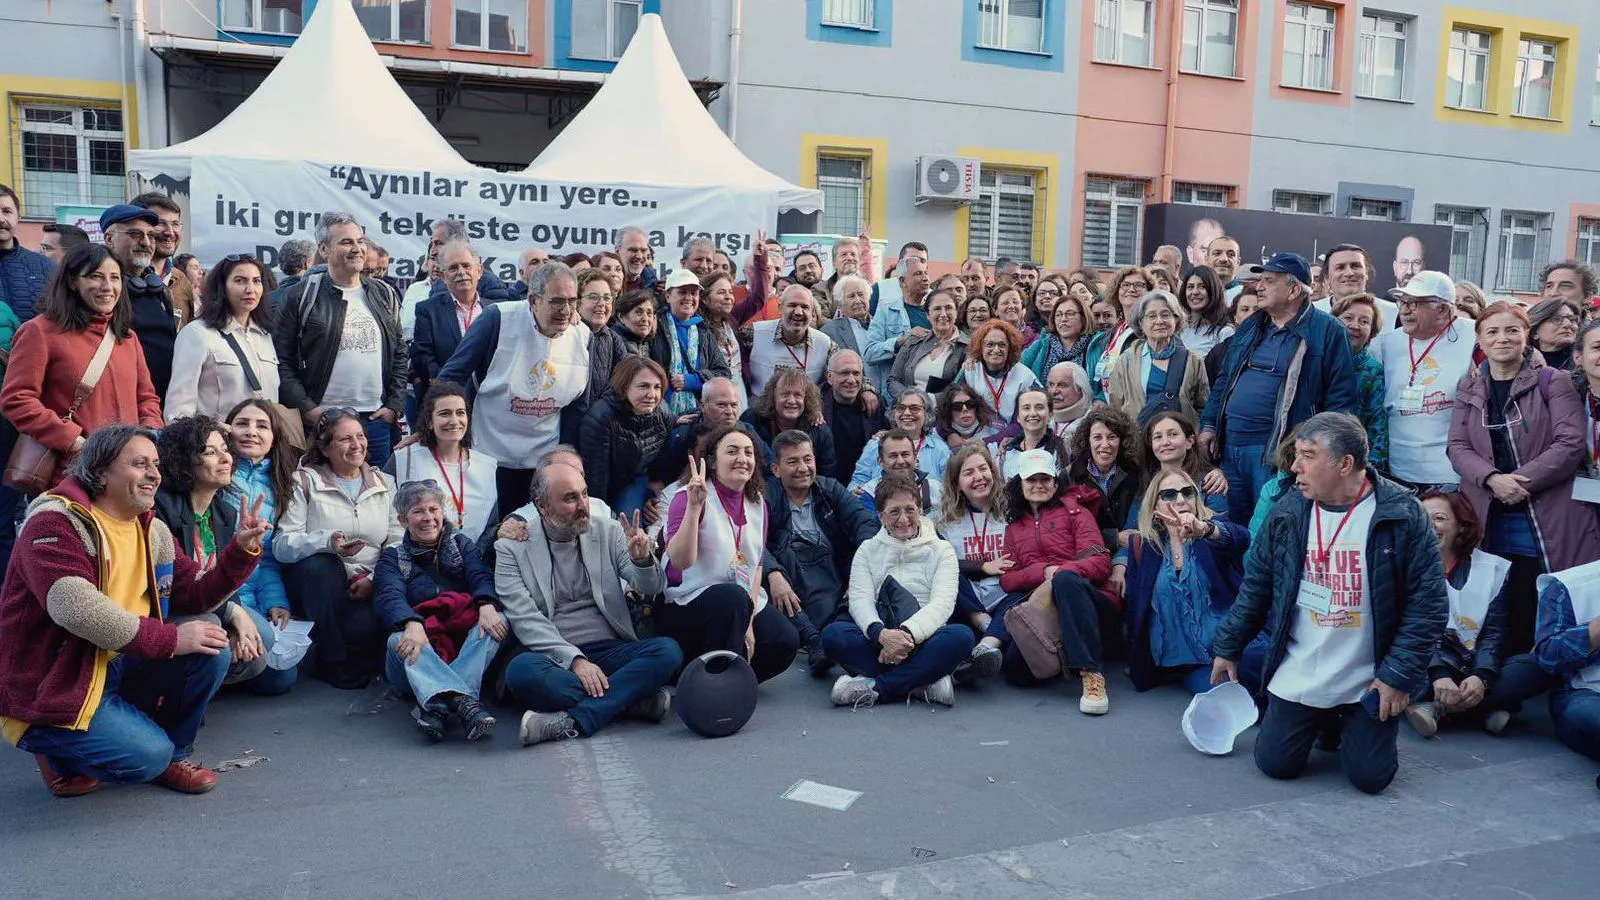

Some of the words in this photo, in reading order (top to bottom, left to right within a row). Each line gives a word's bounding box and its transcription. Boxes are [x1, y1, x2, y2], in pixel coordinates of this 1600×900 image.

[965, 163, 973, 193] VESTEL
[479, 182, 548, 206] aynı
[560, 185, 658, 209] yere...
[215, 194, 260, 228] İki
[379, 212, 434, 236] tek
[532, 223, 666, 249] oyuna
